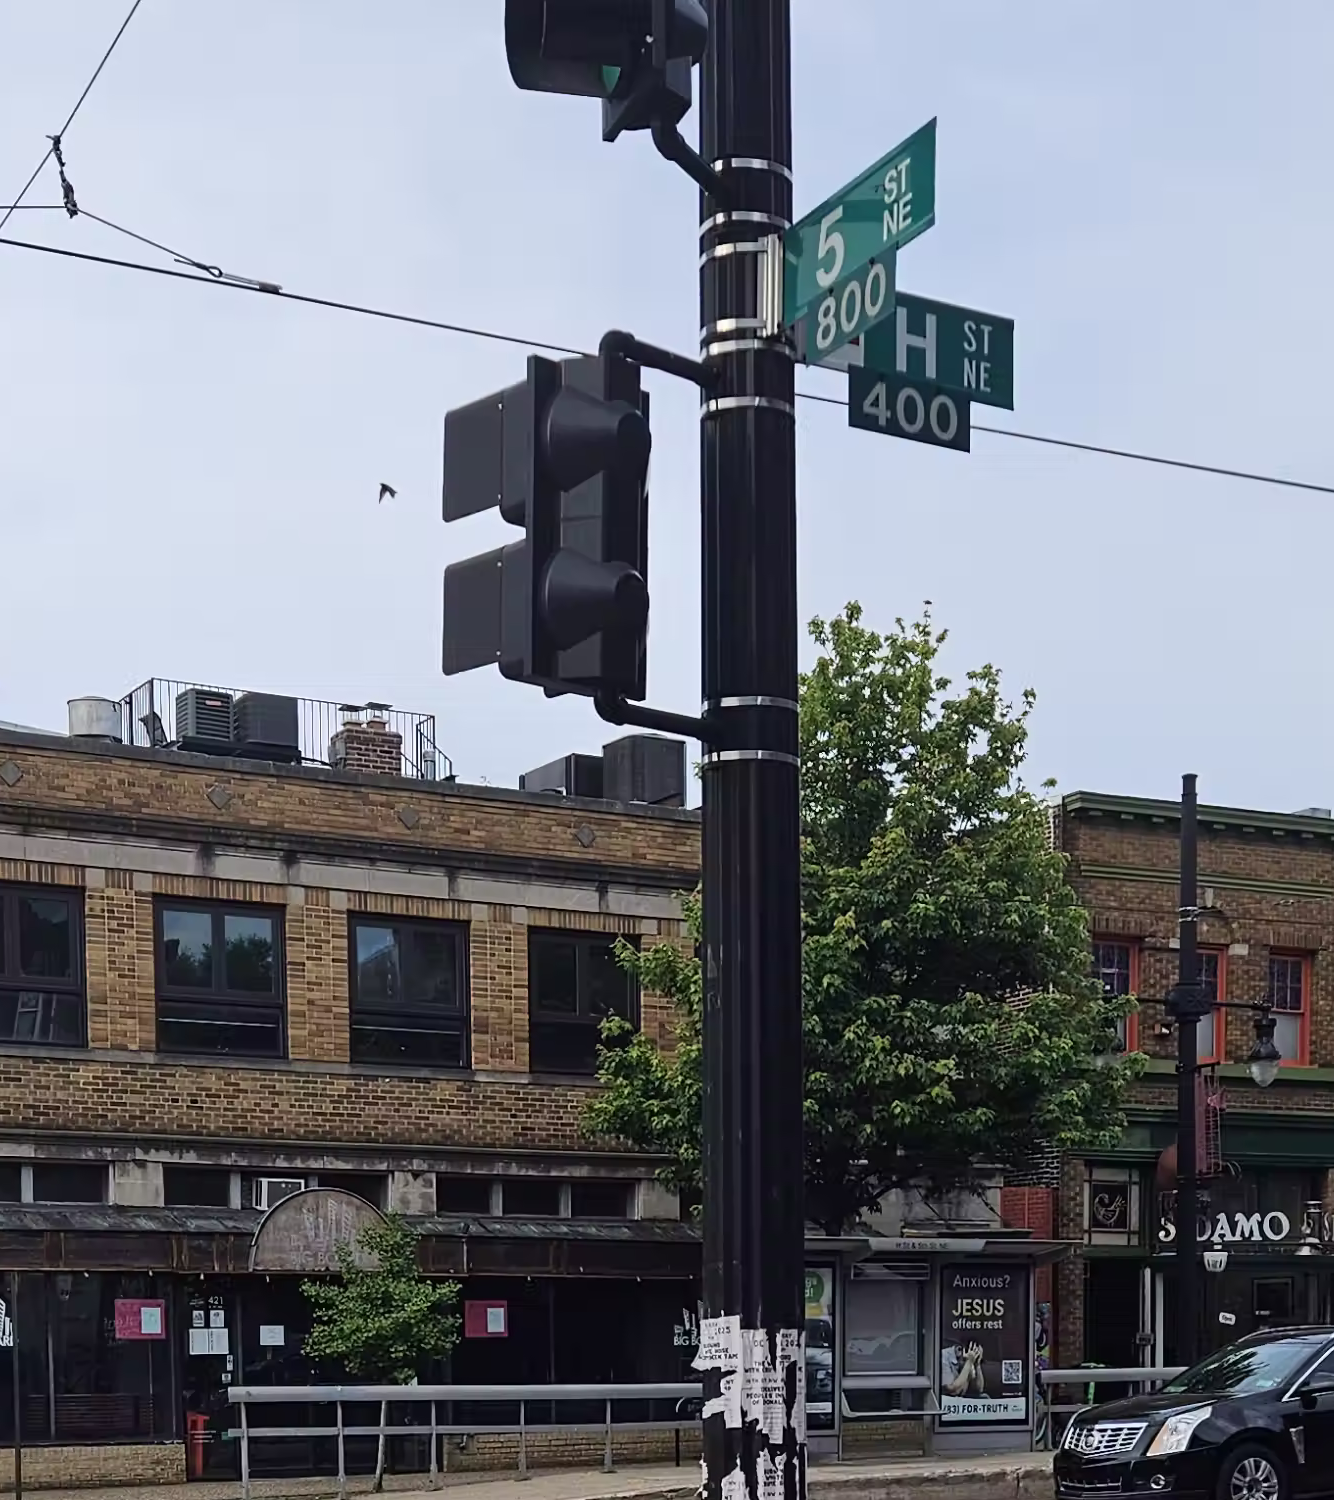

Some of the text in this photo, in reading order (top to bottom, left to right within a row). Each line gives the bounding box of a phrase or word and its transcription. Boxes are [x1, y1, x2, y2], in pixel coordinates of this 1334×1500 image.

[883, 158, 911, 204] ST
[883, 193, 912, 241] NE
[815, 205, 844, 288] 5
[817, 262, 886, 349] 800
[896, 306, 936, 380] H
[963, 320, 992, 355] ST
[963, 357, 991, 392] NE
[863, 381, 958, 441] 400
[1159, 1212, 1290, 1241] SDAMO
[953, 1274, 1010, 1288] Anxious?
[952, 1299, 1004, 1316] JESUS
[952, 1319, 1002, 1329] offers rest
[674, 1335, 689, 1345] BIG
[962, 1404, 1008, 1414] FOR-TRUTH
